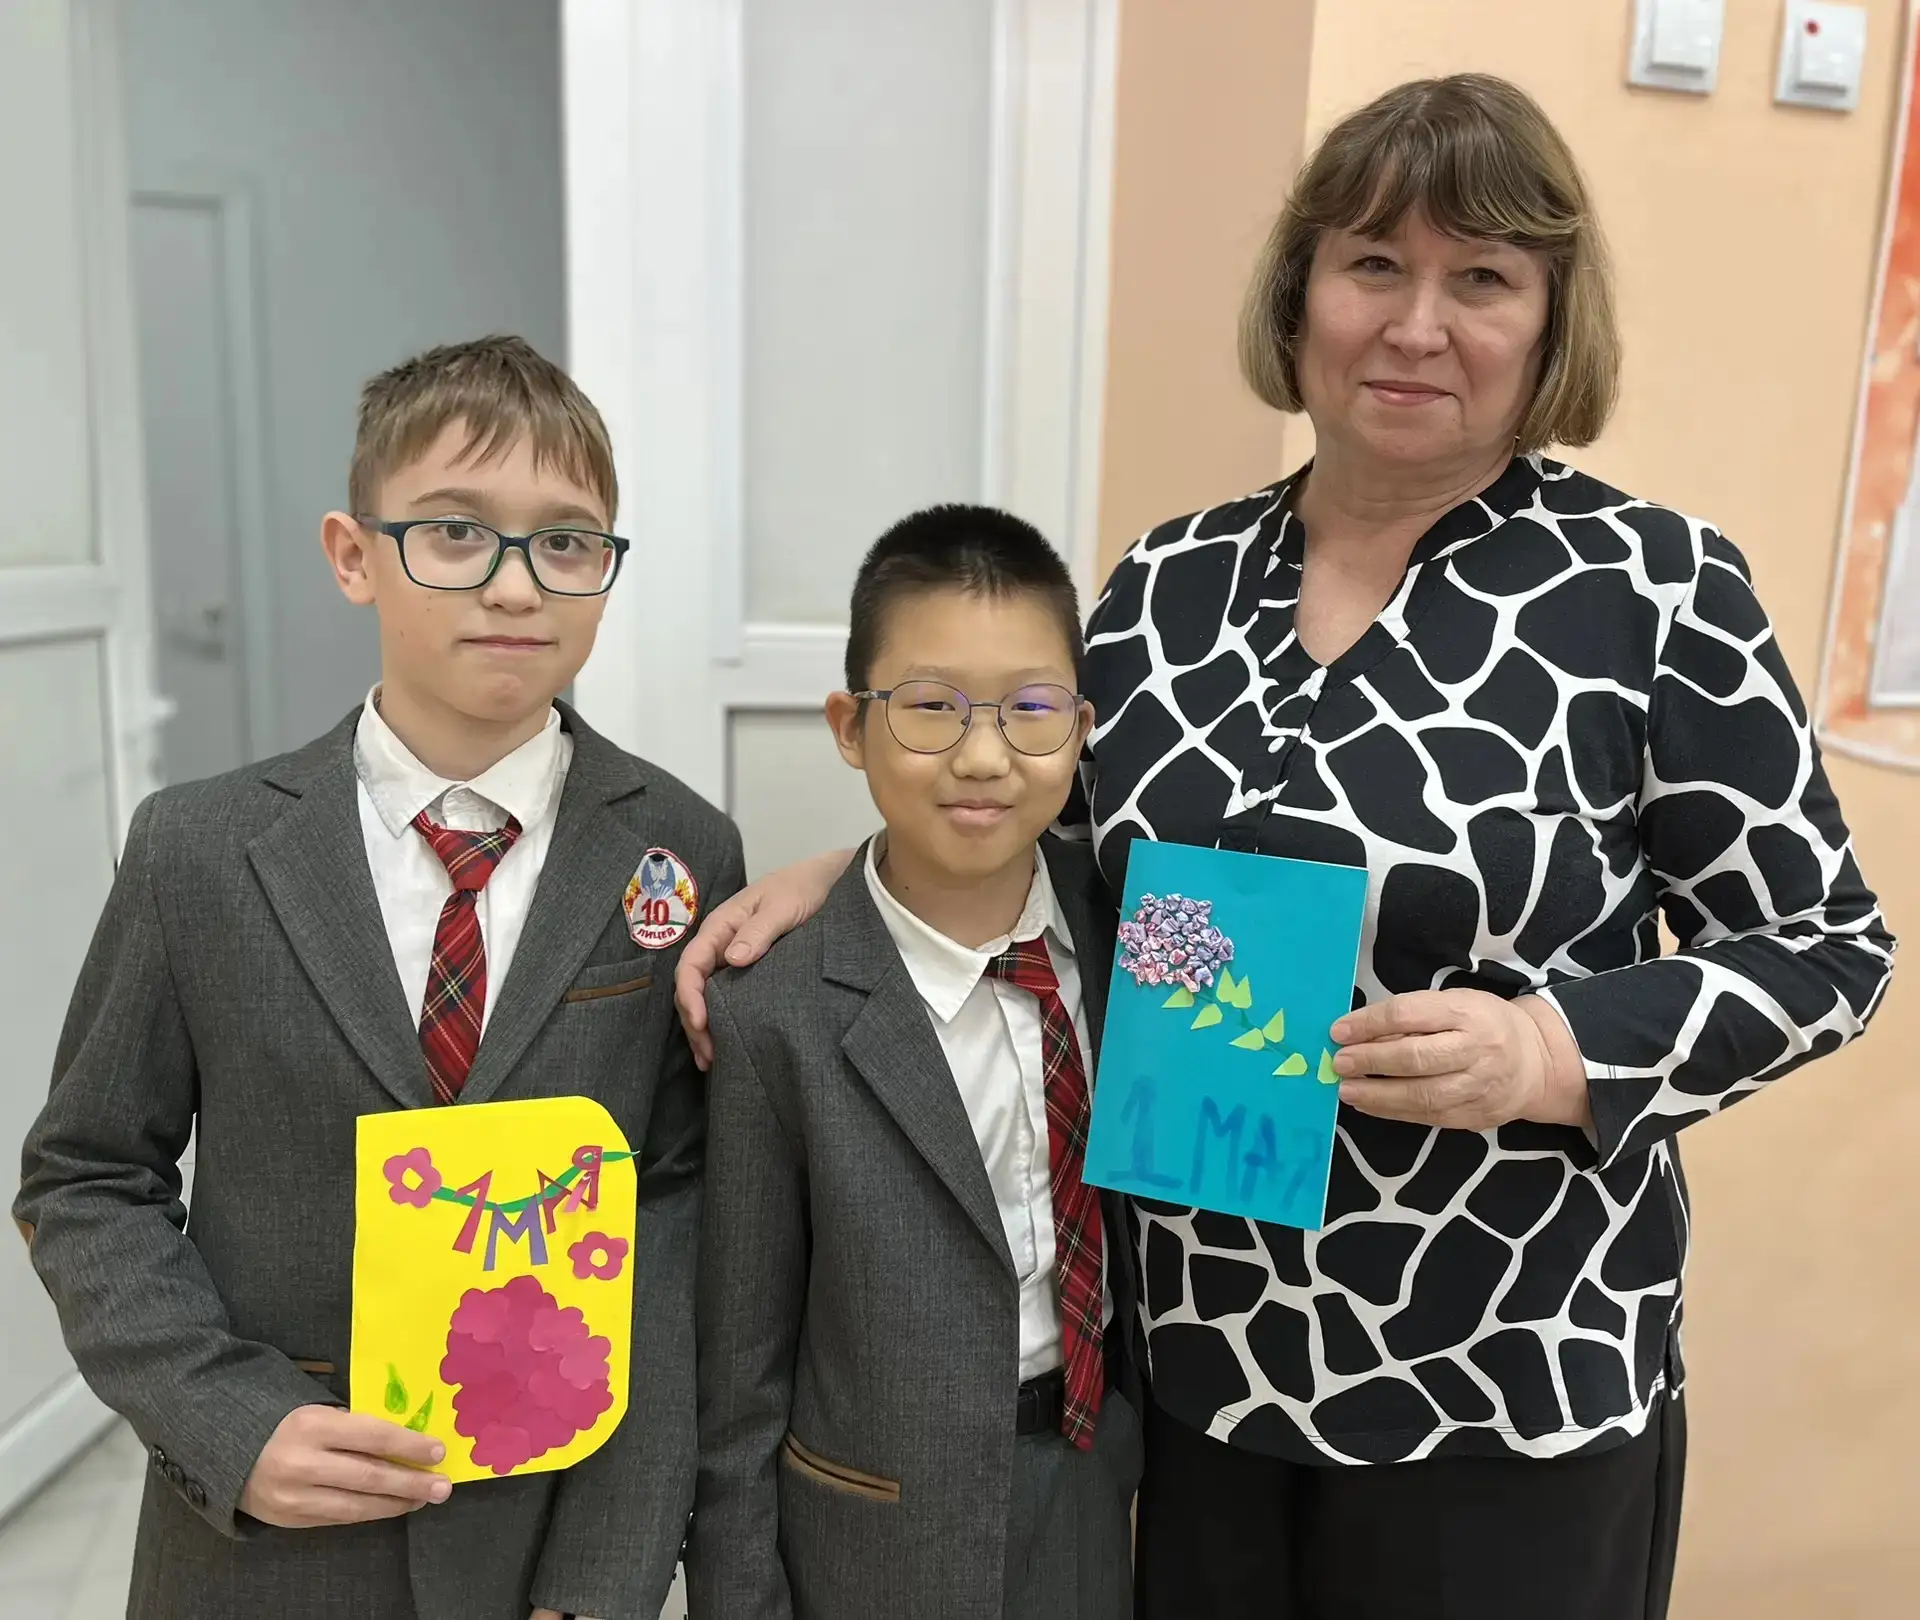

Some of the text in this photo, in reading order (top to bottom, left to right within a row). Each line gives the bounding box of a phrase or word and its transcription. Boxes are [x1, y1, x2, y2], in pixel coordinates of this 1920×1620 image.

[637, 927, 676, 940] ЛИЦЕЙ
[641, 898, 669, 926] 10
[1106, 1074, 1183, 1189] 1
[452, 1169, 493, 1254] 1
